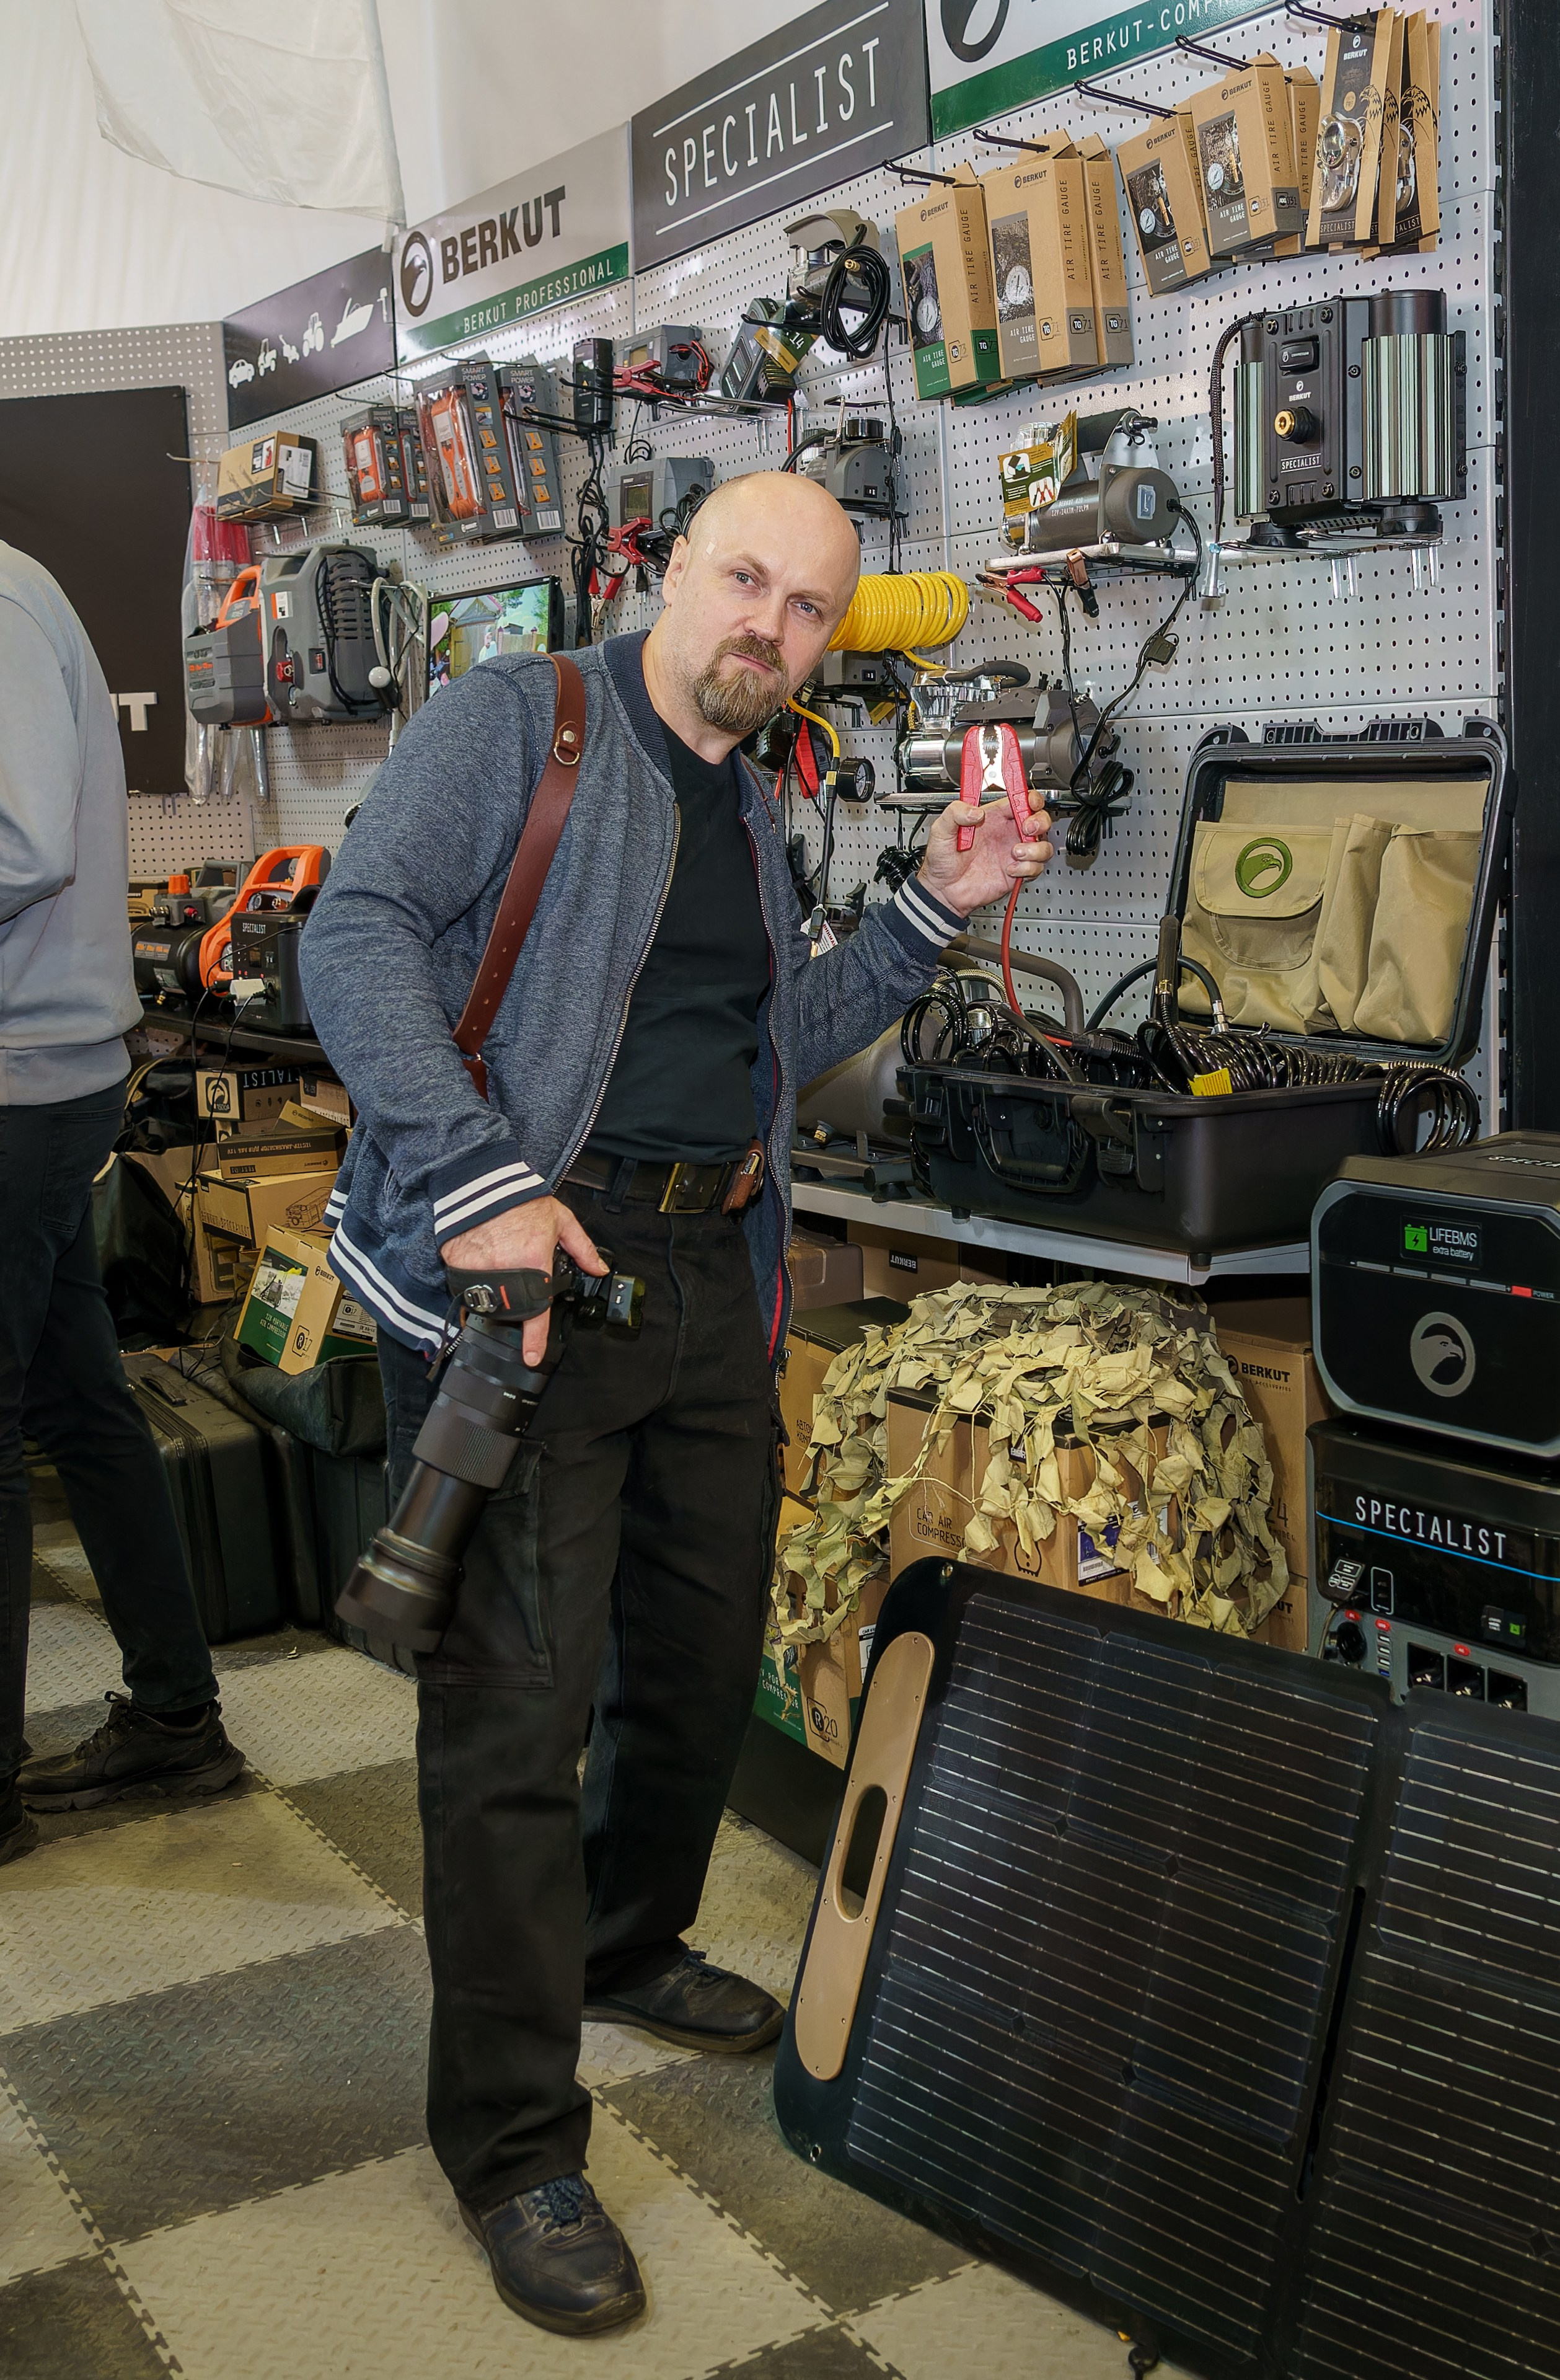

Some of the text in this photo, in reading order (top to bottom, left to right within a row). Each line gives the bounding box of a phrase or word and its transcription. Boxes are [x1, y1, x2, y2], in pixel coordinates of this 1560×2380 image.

[1343, 48, 1368, 61] BERKUT
[1229, 80, 1253, 95] BERKUT
[664, 37, 879, 206] SPECIALIST
[1298, 100, 1306, 133] GAUGE
[1262, 80, 1280, 172] AIR TIRE GAUGE
[1153, 128, 1176, 145] BERKUT
[1185, 128, 1197, 162] GAUGE
[1023, 170, 1047, 184] BERKUT
[927, 201, 949, 216] BERKUT
[1219, 203, 1245, 219] AIR TIRE
[1230, 211, 1245, 223] GAUGE
[1059, 180, 1075, 280] AIR TIRE GAUGE
[1091, 181, 1111, 280] AIR TIRE GAUGE
[1320, 220, 1355, 233] SPECIALIST
[441, 185, 566, 285] BERKUT
[960, 209, 979, 303] AIR TIRE GAUGE
[1155, 244, 1178, 261] AIR TIRE
[1165, 252, 1180, 264] GAUGE
[464, 259, 614, 334] BERKUT PROFESSIONAL
[1010, 325, 1034, 337] AIR TIRE
[1020, 334, 1035, 343] GAUGE
[922, 349, 944, 363] AIR TIRE
[931, 358, 946, 368] GAUGE
[462, 366, 485, 375] SMART
[1289, 391, 1311, 402] BERKUT
[1281, 456, 1320, 471] SPECIALIST
[242, 922, 267, 934] SPECIALIST
[1489, 1155, 1560, 1168] SPECIA
[1429, 1227, 1478, 1248] LIFEBMS
[1433, 1246, 1474, 1262] extra battery
[890, 1255, 917, 1269] BERKUT
[1533, 1290, 1555, 1299] POWER
[1241, 1362, 1290, 1383] BERKUT
[917, 1508, 952, 1529] CAR AIR
[1355, 1496, 1507, 1559] SPECIALIST
